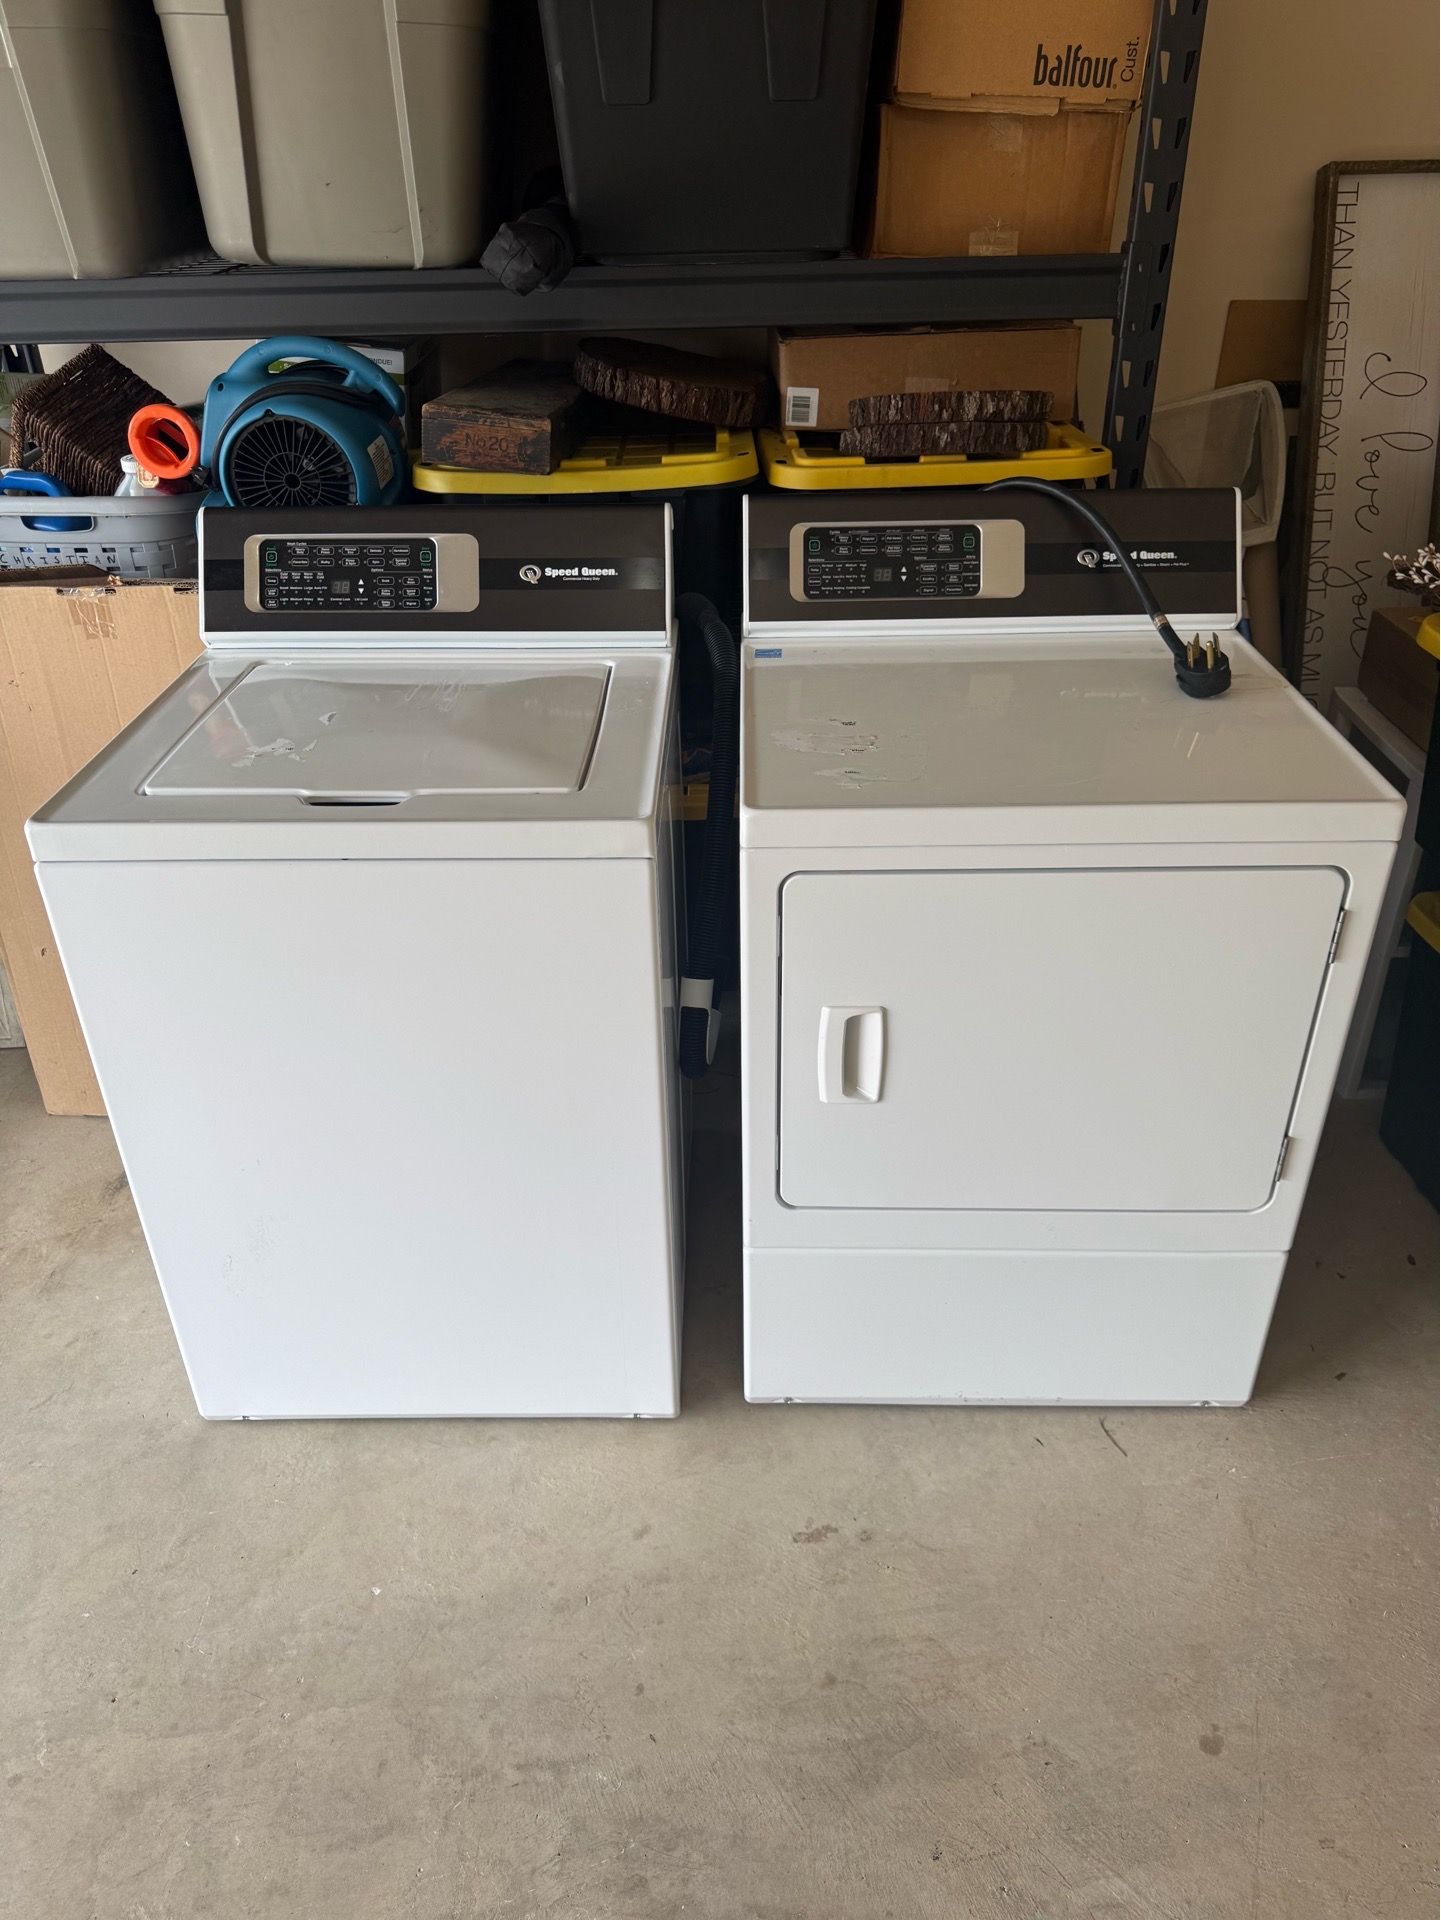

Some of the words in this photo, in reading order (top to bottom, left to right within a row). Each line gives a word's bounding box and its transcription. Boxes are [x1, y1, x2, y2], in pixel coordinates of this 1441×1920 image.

[1033, 43, 1118, 88] balfour
[1120, 36, 1140, 82] Cust.
[1332, 182, 1360, 269] THAN
[1360, 352, 1428, 400] I
[1313, 473, 1336, 531] BUT
[1354, 431, 1434, 534] love
[544, 567, 579, 578] Speed
[1102, 551, 1137, 562] Spd
[1308, 540, 1331, 600] NOT
[1303, 607, 1325, 643] AS
[1322, 559, 1374, 660] you
